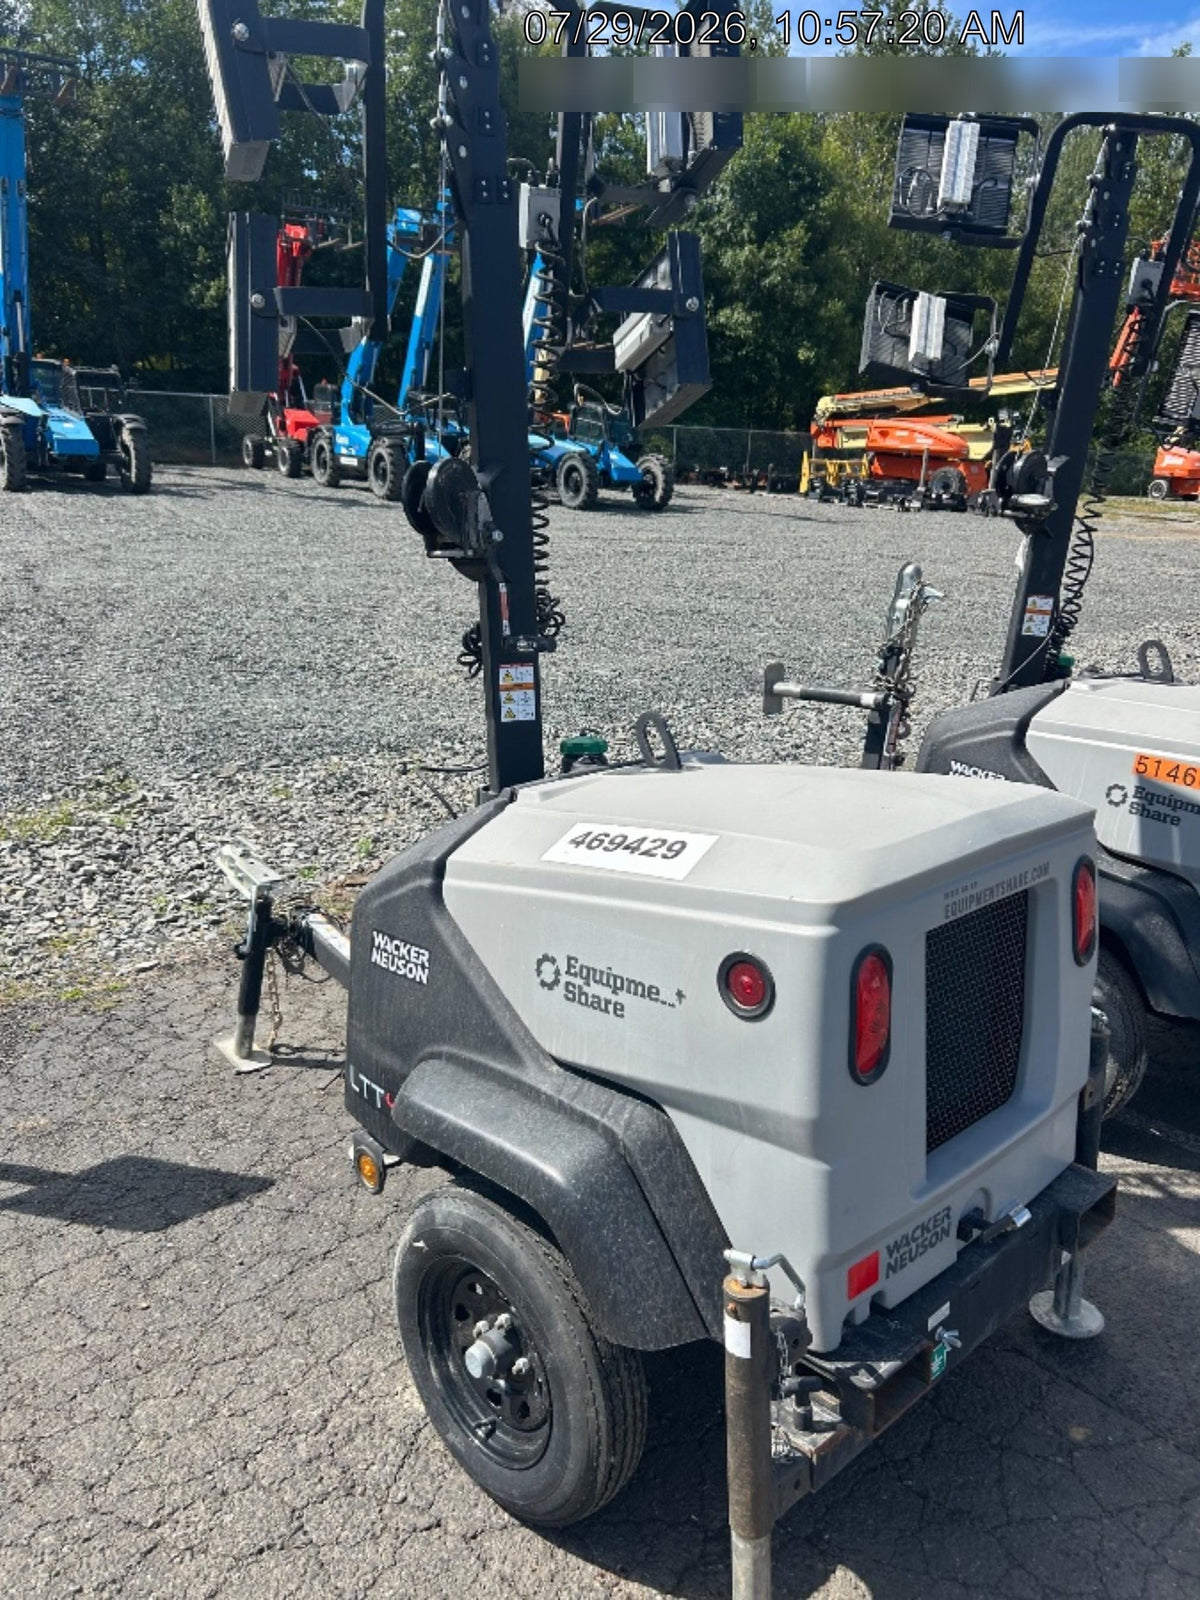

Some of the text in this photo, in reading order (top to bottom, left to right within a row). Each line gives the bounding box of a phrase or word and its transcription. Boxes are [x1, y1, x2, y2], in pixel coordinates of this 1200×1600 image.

[1134, 754, 1200, 787] 5146
[1128, 801, 1181, 826] Share
[568, 831, 688, 859] 469429
[370, 946, 429, 985] NEUSON
[372, 930, 430, 968] WACKER
[565, 954, 687, 1005] Equipmet
[563, 980, 625, 1018] Share
[885, 1205, 952, 1259] WACKER
[885, 1221, 951, 1279] NEUSON
